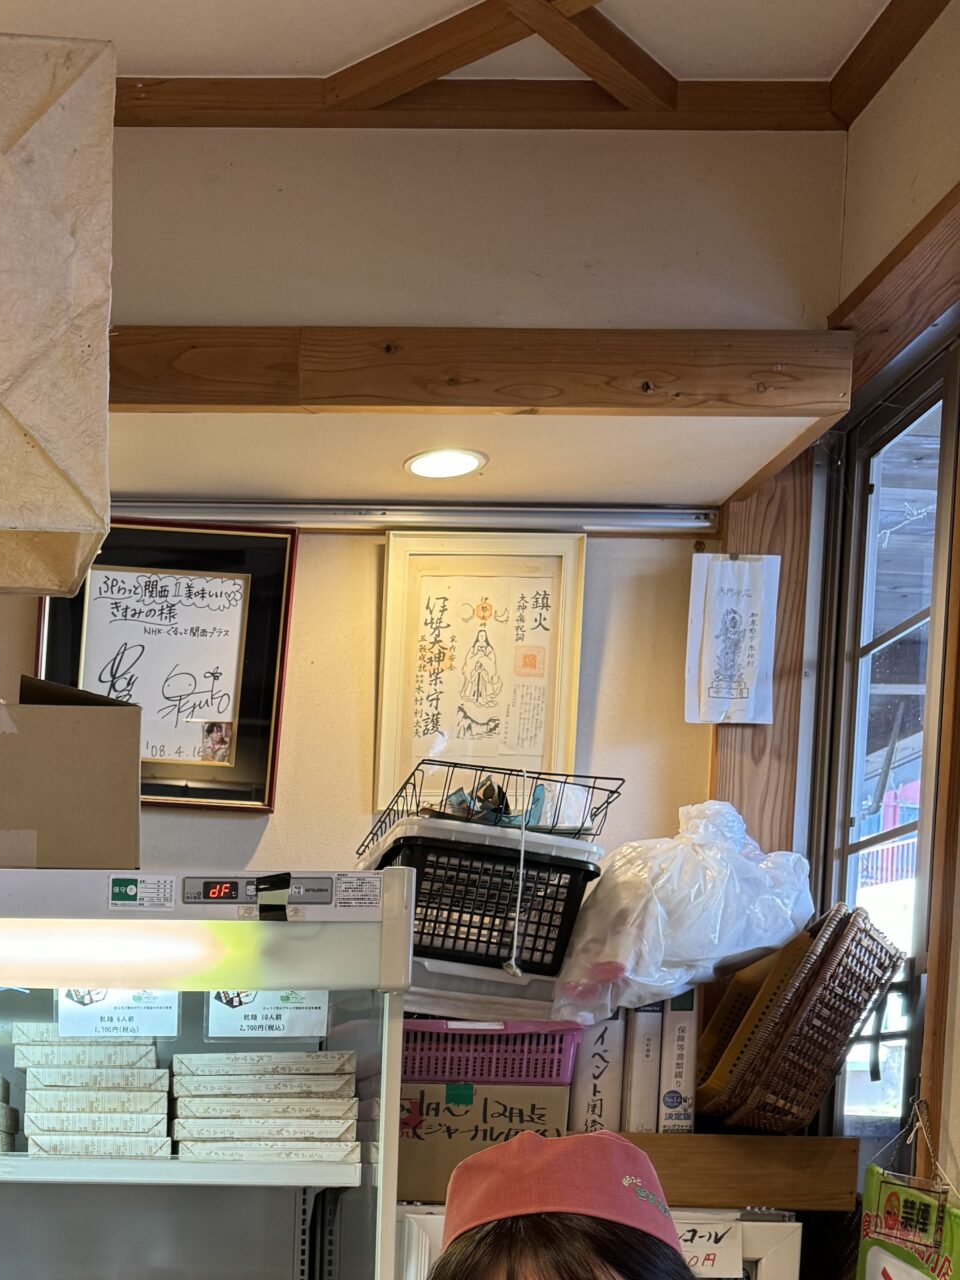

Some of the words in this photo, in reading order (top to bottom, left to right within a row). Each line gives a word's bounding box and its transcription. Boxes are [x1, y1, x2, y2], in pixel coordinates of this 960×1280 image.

[110, 601, 179, 622] きすみの様
[530, 590, 552, 632] 鎮火
[678, 1226, 733, 1245] コール
